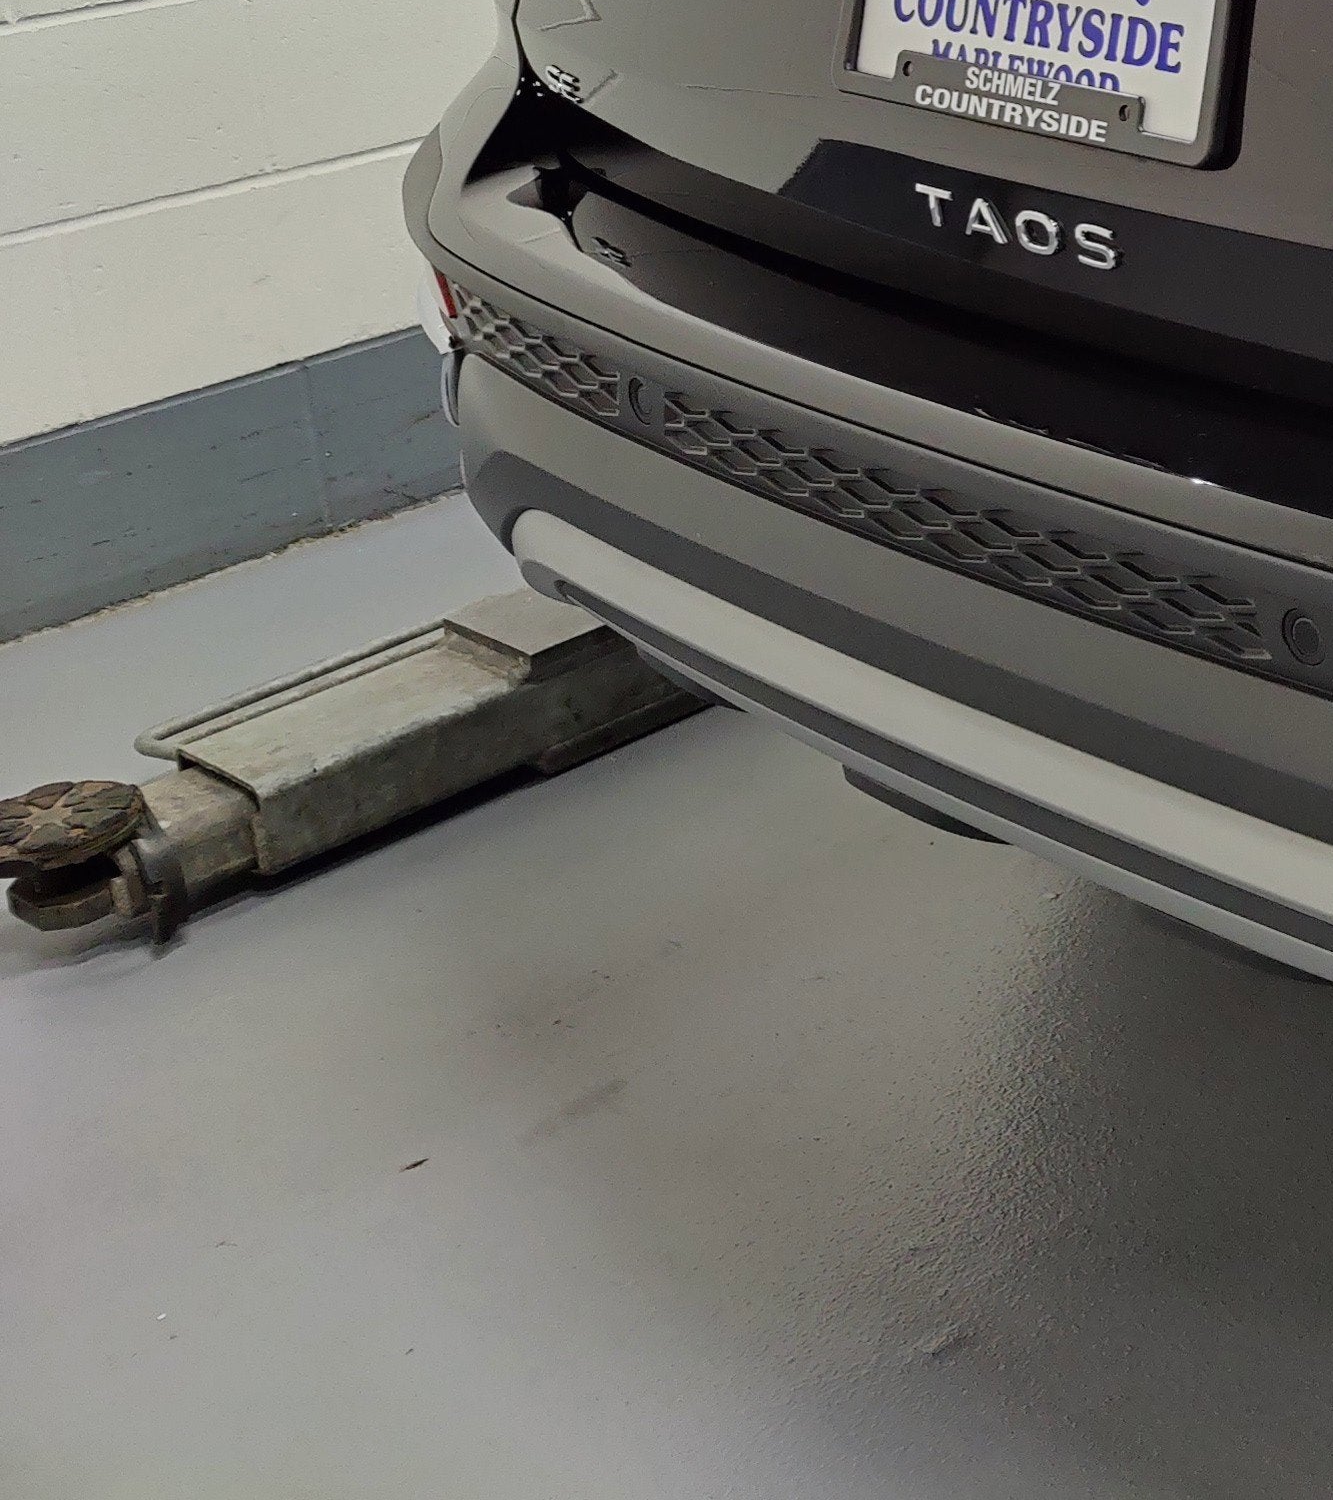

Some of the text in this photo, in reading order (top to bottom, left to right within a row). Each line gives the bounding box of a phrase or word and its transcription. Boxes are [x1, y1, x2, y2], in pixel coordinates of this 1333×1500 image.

[914, 84, 1109, 143] COUNTRYSIDE
[964, 65, 1062, 107] SCHMELZ
[914, 182, 1118, 271] TAOS
